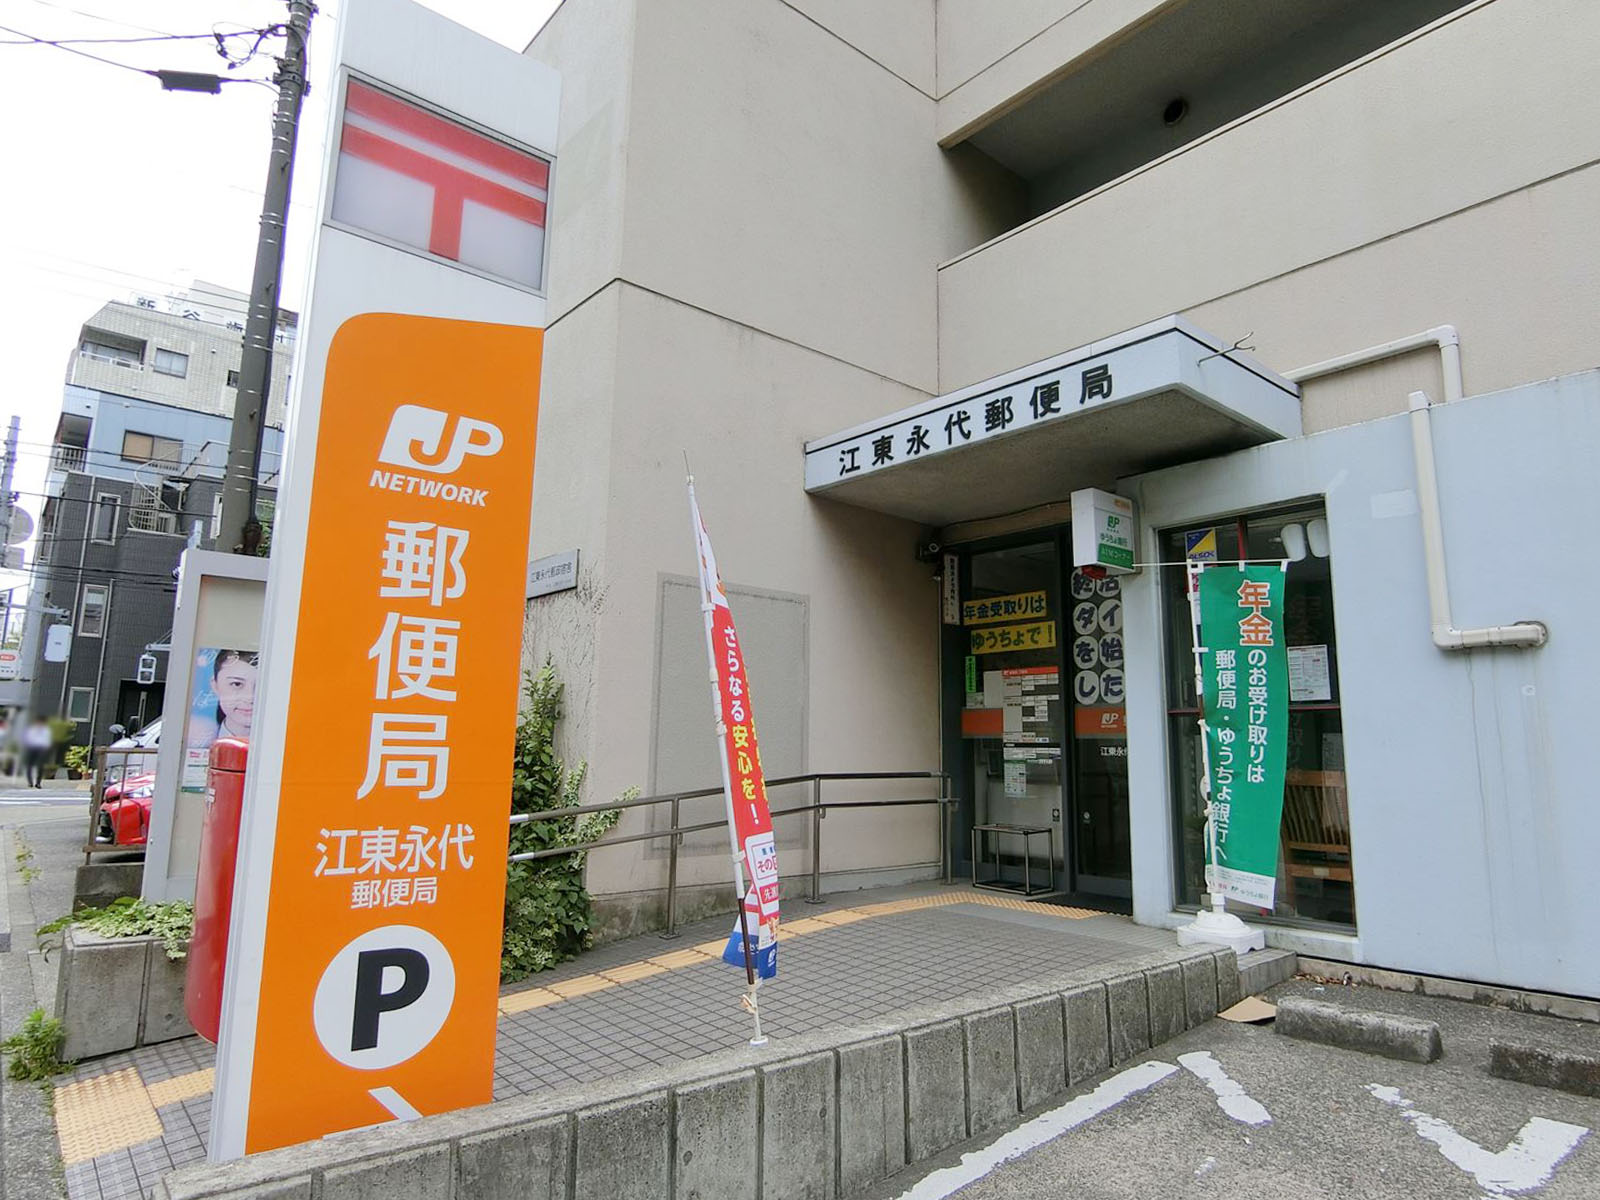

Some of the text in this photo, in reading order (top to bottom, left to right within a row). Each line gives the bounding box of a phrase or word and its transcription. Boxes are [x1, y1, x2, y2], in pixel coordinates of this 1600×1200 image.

[377, 404, 504, 475] JP
[838, 363, 1114, 477] 江東永代郵便局
[368, 470, 489, 507] NETWORK
[963, 594, 1046, 620] 年金受取りは
[356, 519, 471, 802] 郵便局
[1237, 579, 1275, 784] 年金のお受け取りは
[313, 822, 477, 878] 江東永代
[350, 876, 439, 911] 郵便局
[350, 946, 431, 1054] P
